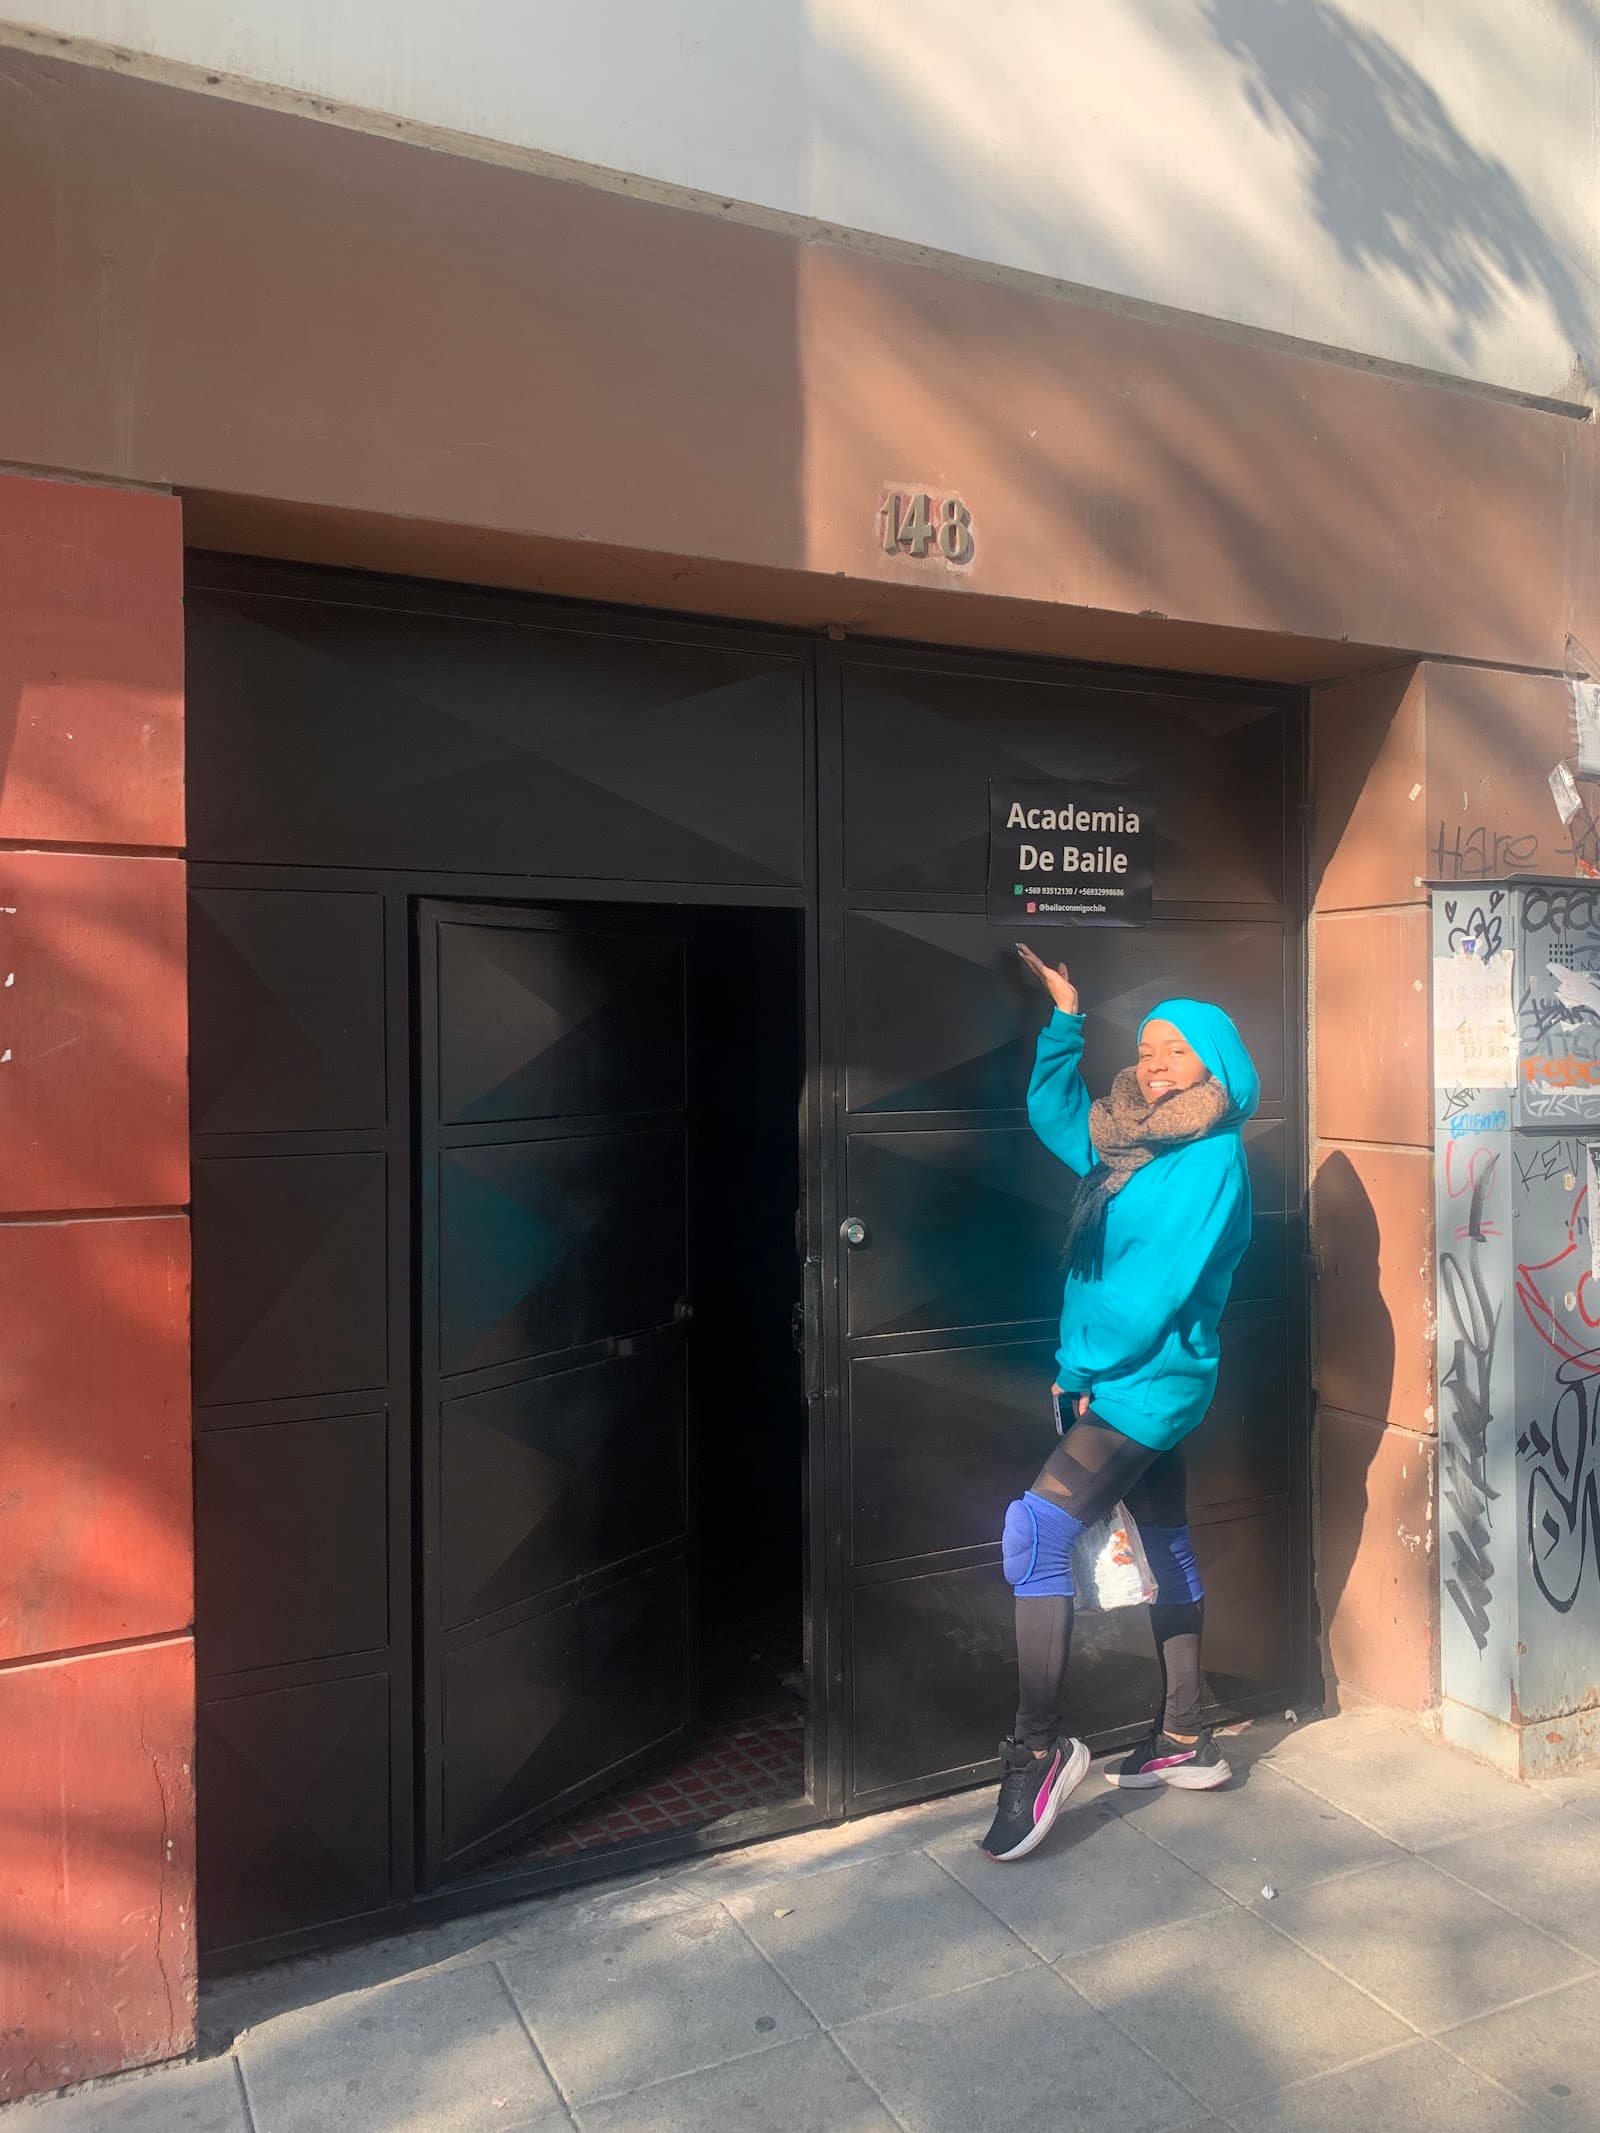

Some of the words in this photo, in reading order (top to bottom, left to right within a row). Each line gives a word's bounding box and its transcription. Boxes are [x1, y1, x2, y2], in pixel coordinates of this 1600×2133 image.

[880, 492, 972, 563] 148
[1006, 802, 1140, 833] Academia
[1019, 844, 1055, 872] De
[1063, 846, 1128, 873] Baile
[1024, 886, 1040, 895] +569
